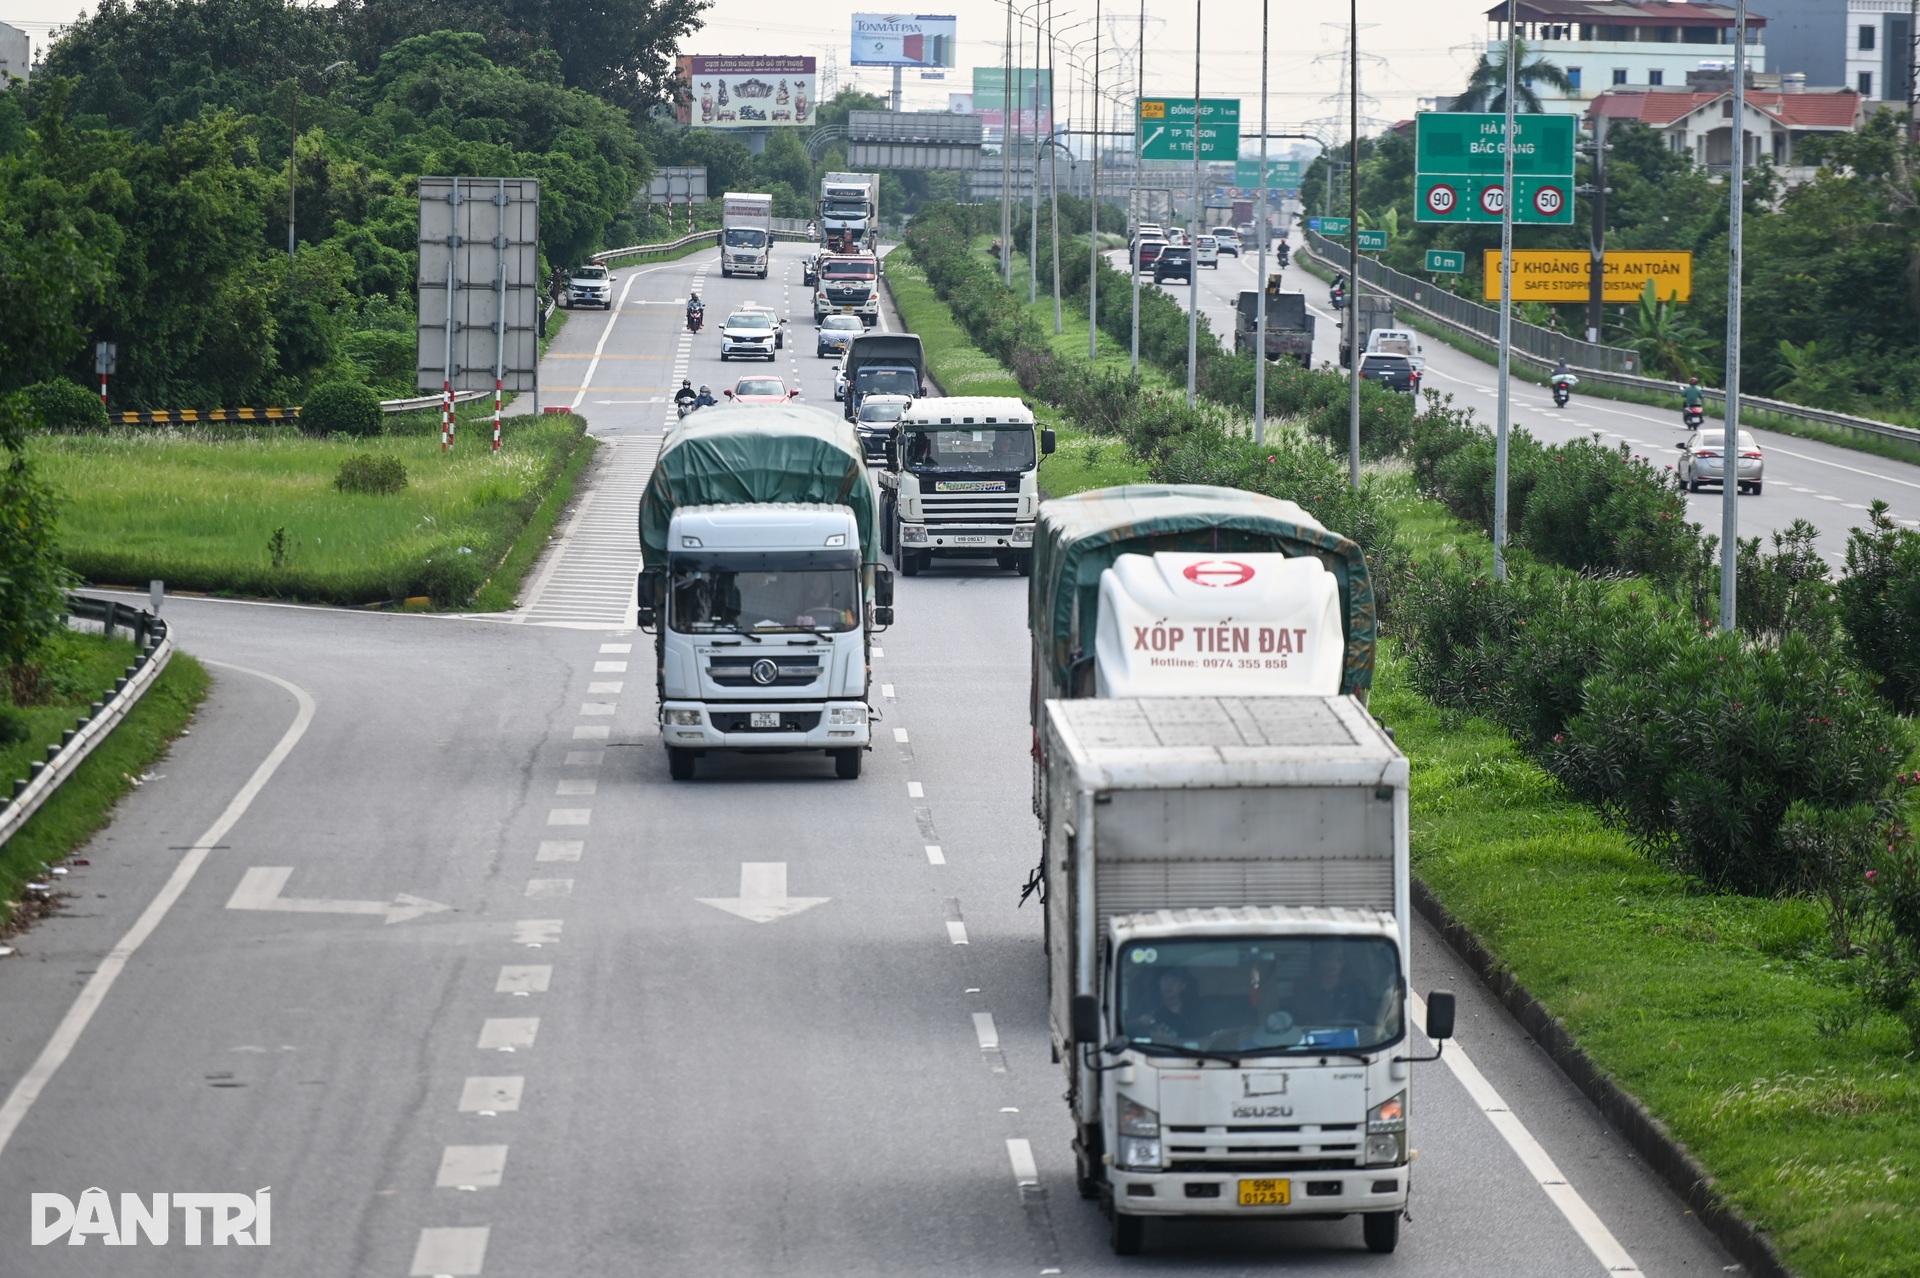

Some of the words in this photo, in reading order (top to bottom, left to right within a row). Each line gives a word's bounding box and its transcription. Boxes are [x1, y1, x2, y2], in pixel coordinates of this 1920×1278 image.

[1480, 120, 1498, 134] HÀ
[1180, 141, 1195, 151] TIÊ
[1470, 138, 1495, 153] BẮC
[1497, 143, 1535, 154] GANG
[1433, 192, 1450, 206] 90
[1488, 193, 1504, 207] 70
[1540, 193, 1558, 207] 50
[1358, 235, 1370, 244] 70
[1434, 256, 1441, 266] 0
[1444, 259, 1455, 267] m
[1496, 259, 1519, 273] GỮ
[1524, 259, 1580, 274] KHOẢNG
[1584, 262, 1619, 274] CCH
[1524, 281, 1549, 290] SAFE
[1552, 281, 1592, 290] STOPPI
[1604, 282, 1646, 291] DISTANC
[1134, 617, 1184, 651] XỐP
[1193, 616, 1249, 652] TIẾN
[1259, 628, 1307, 657] ĐẠT
[1151, 657, 1198, 667] Hotline:
[1203, 658, 1233, 668] 0974
[1238, 659, 1260, 668] 355
[1265, 659, 1288, 669] 858
[1233, 1106, 1293, 1118] ISUZU
[1253, 1181, 1275, 1191] 99H
[1244, 1192, 1284, 1203] 012.53
